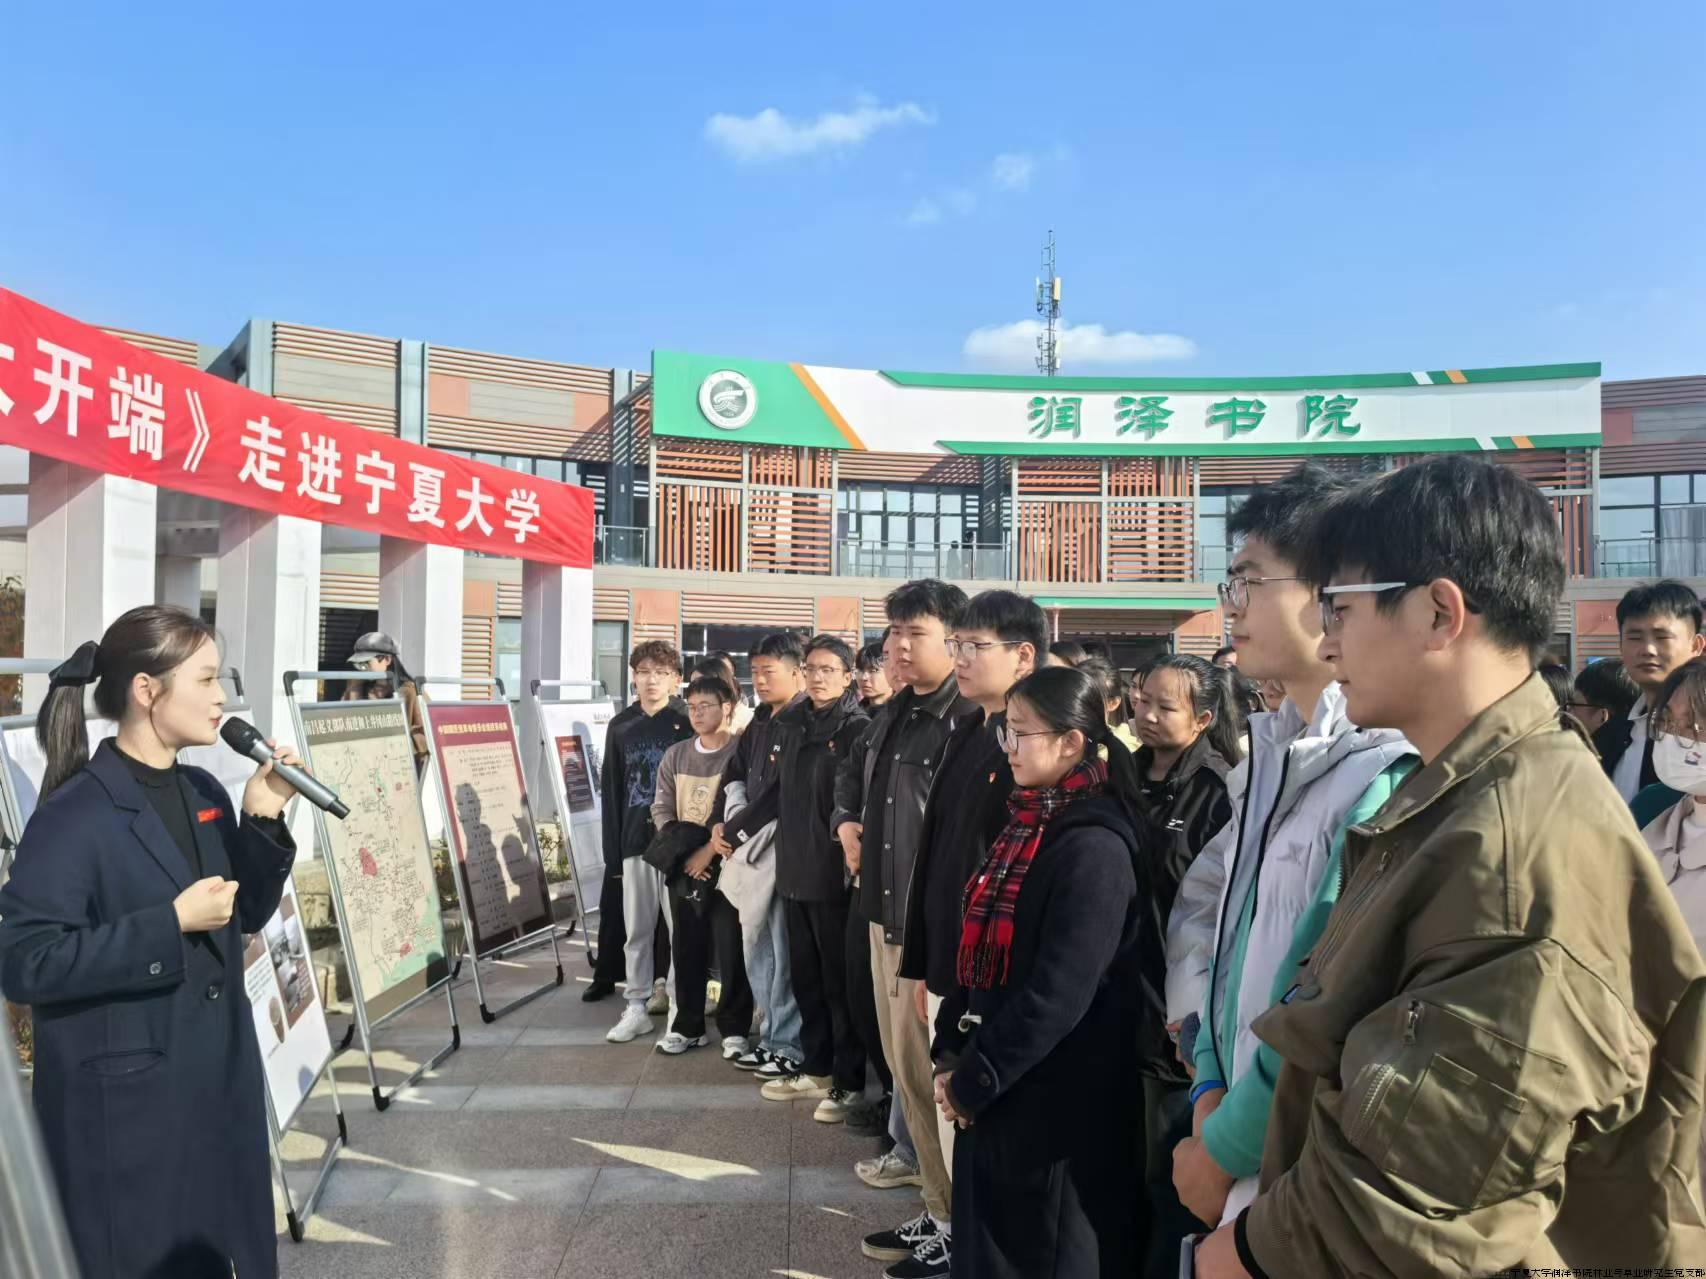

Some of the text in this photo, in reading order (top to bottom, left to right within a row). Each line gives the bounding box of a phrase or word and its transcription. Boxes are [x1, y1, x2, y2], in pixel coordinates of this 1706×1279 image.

[0, 337, 541, 544] 开端》走进宁夏大学
[1028, 394, 1362, 439] 润泽书院
